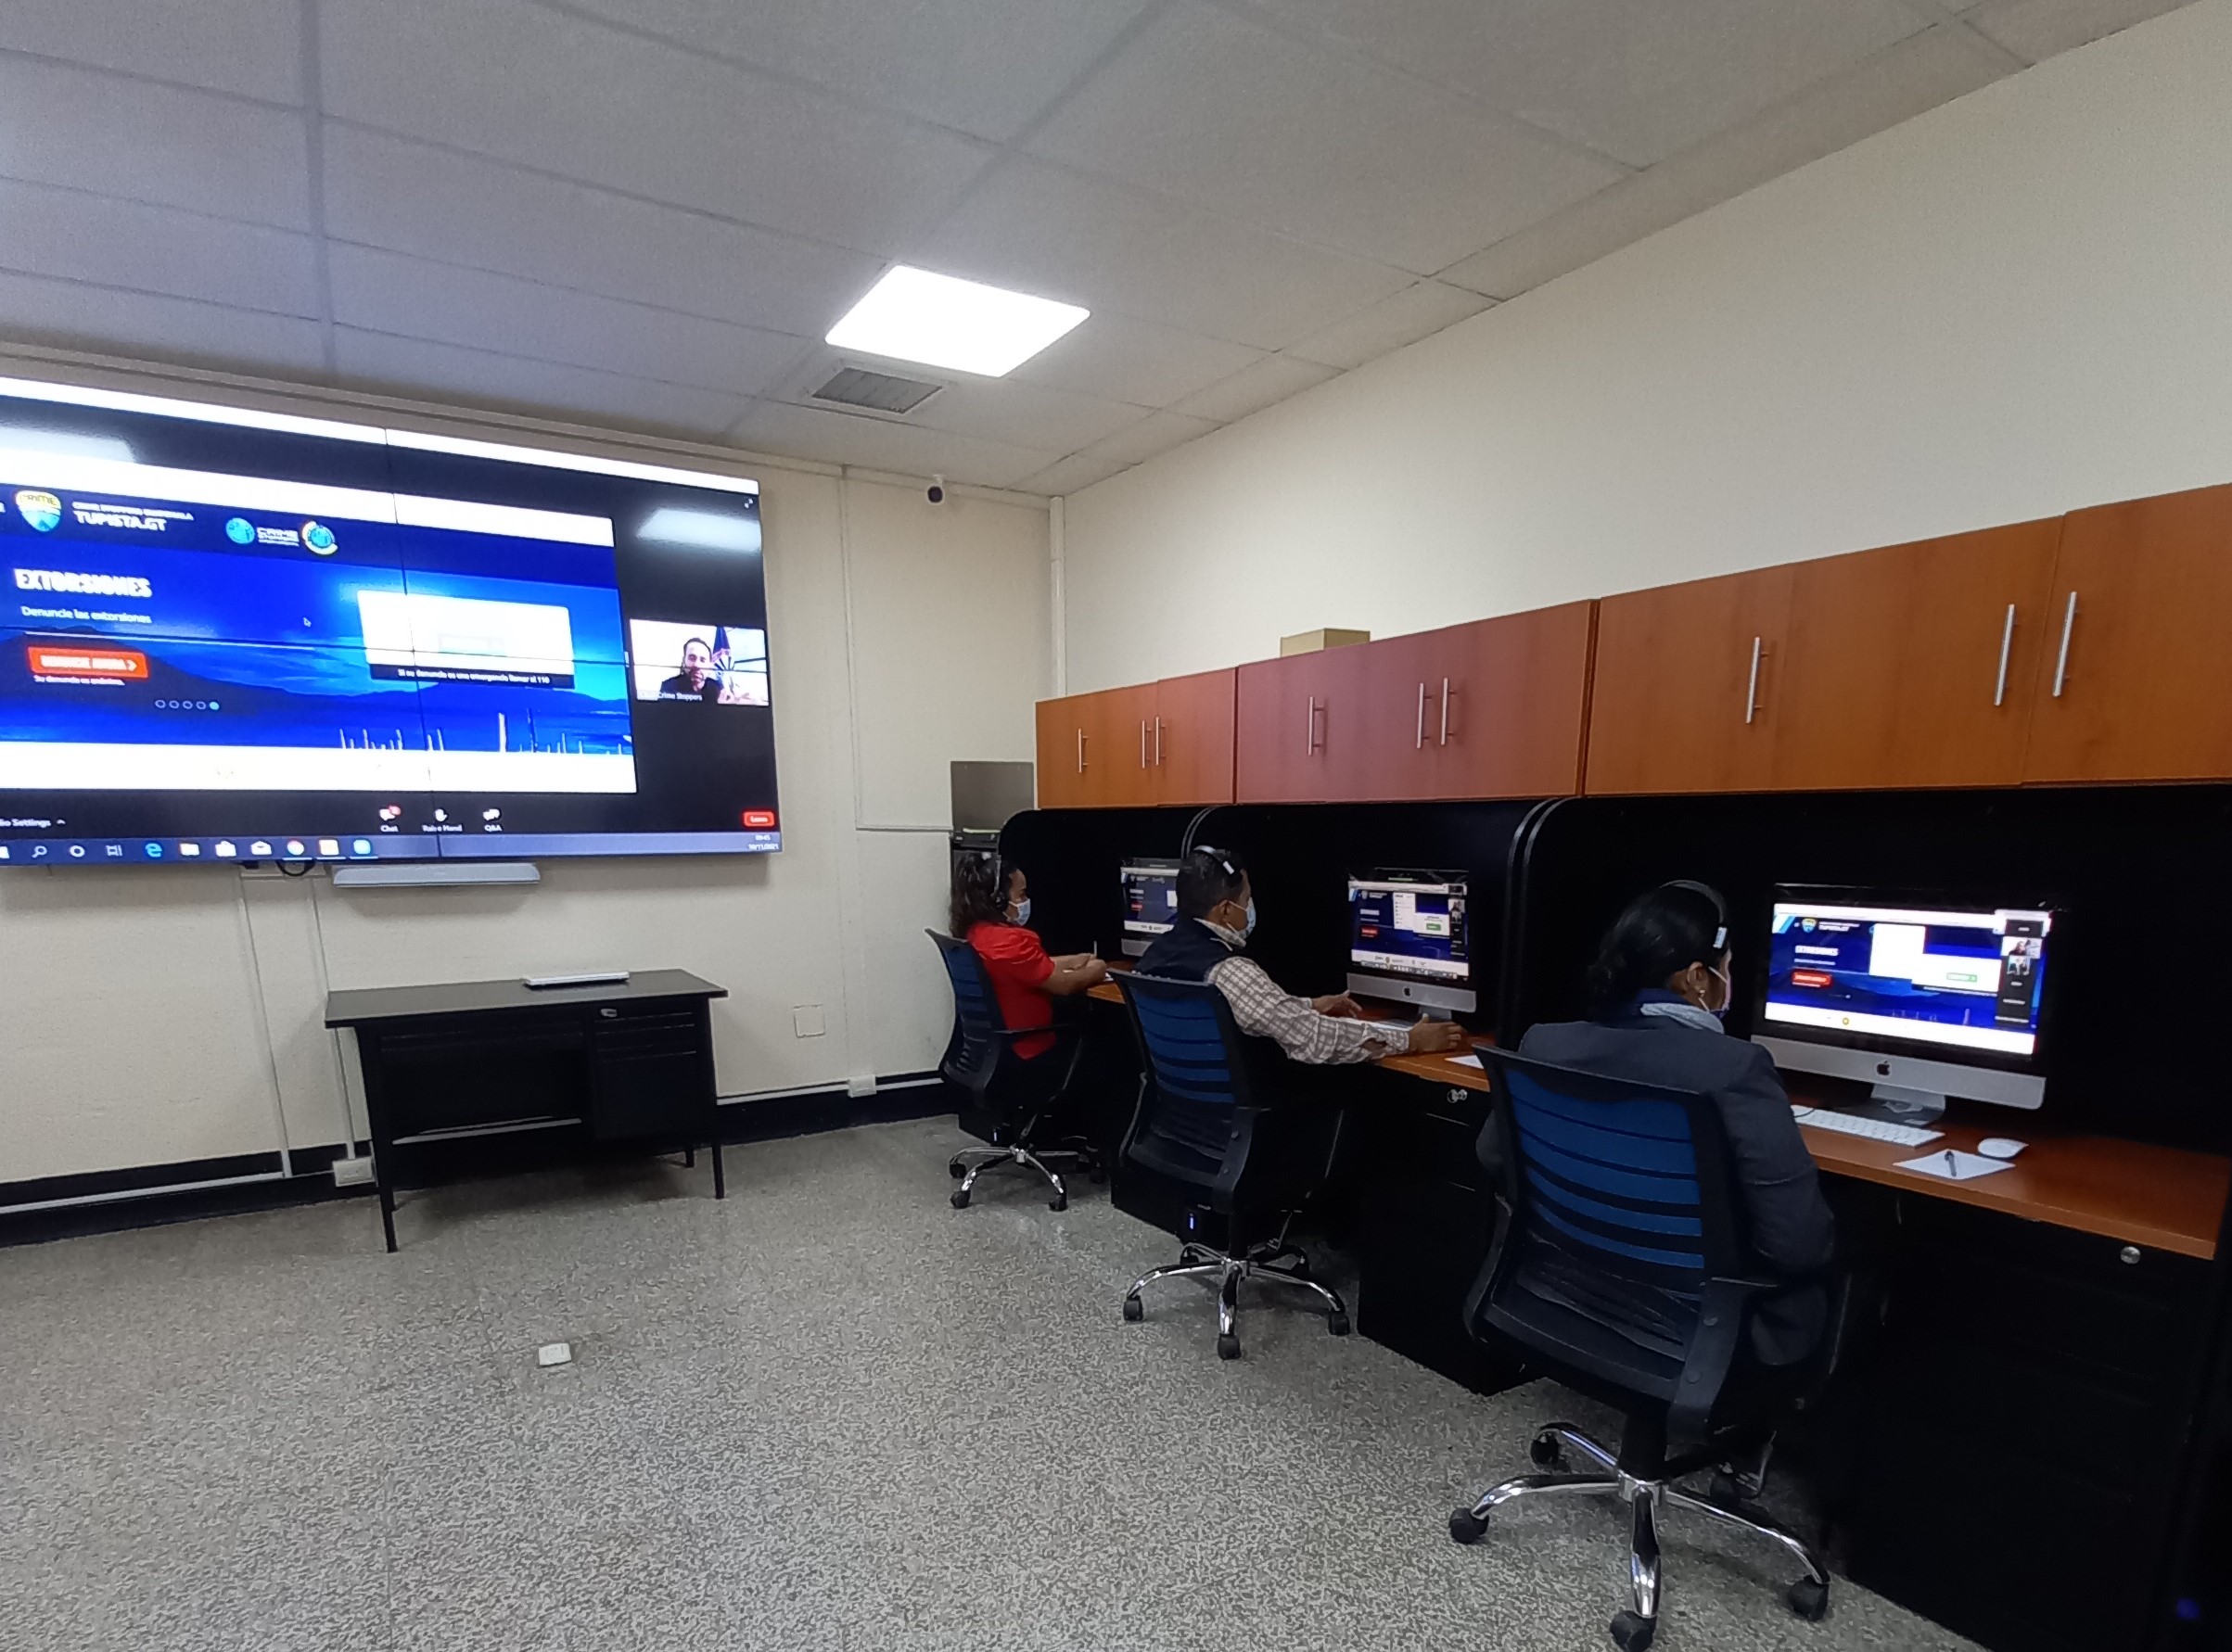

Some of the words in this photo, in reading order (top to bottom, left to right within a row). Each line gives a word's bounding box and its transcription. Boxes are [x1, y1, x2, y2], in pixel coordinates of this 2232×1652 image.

[14, 568, 153, 598] EXTORSIONES
[20, 605, 73, 618] Denuncie
[73, 608, 90, 619] las
[91, 612, 152, 624] extorsiones
[11, 819, 51, 828] Settings
[380, 824, 399, 832] Chat
